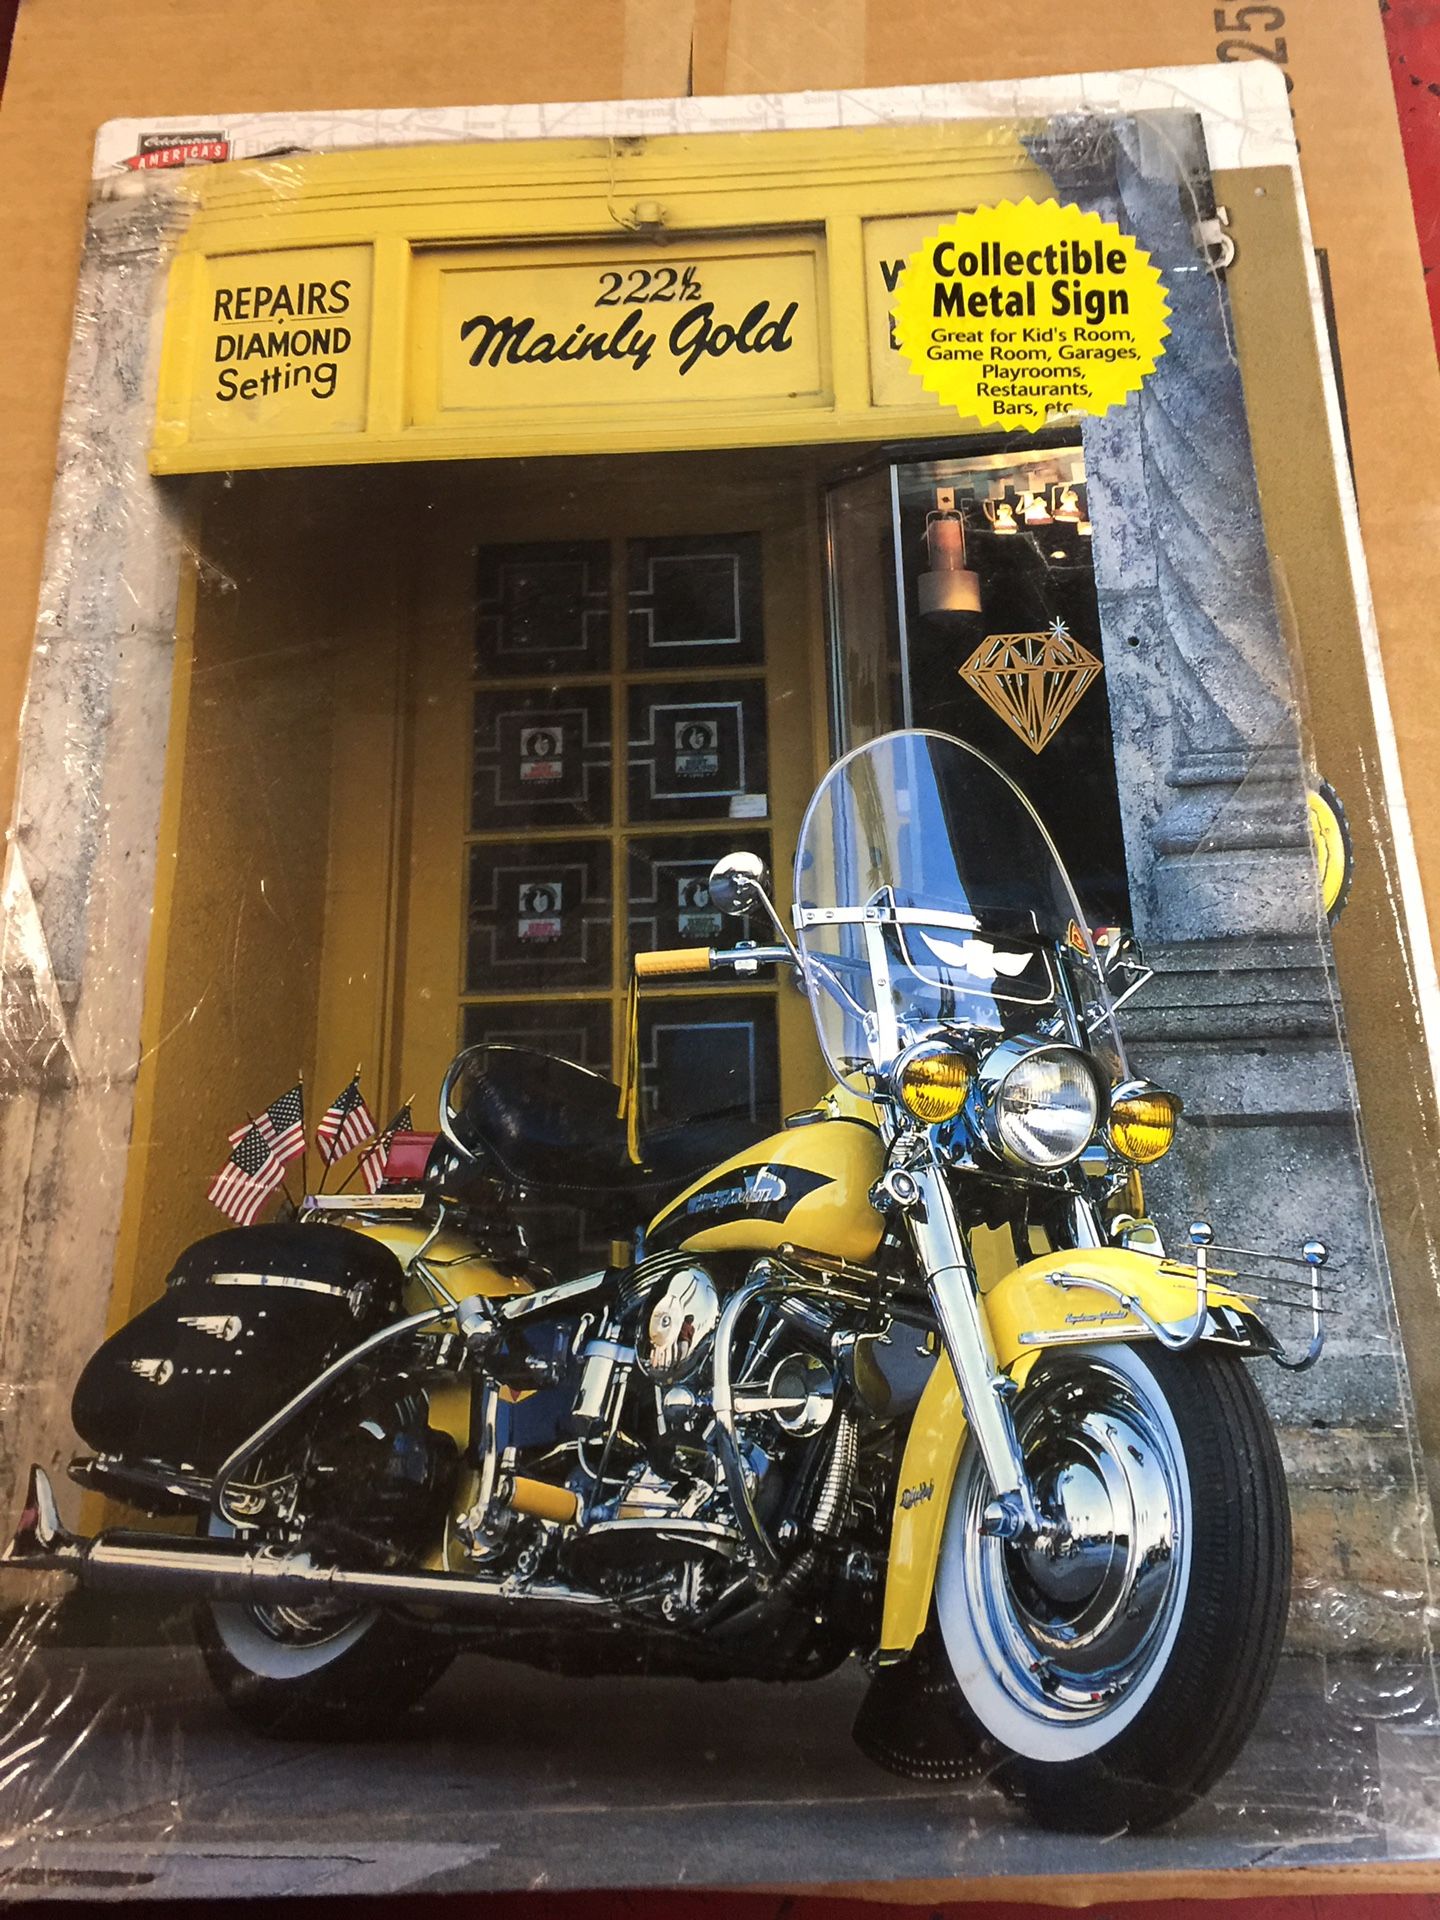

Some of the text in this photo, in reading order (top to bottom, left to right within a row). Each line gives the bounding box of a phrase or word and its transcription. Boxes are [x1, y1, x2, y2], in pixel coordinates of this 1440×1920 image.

[138, 144, 223, 170] AMERICA'S
[932, 239, 1127, 278] Collectible
[213, 279, 351, 322] REPAIRS
[932, 280, 1130, 325] Metal Sign
[214, 327, 352, 363] DIAMOND
[460, 300, 800, 377] Mainly Gold
[930, 327, 1136, 344] Great for Kid's Room,
[926, 344, 1142, 363] Game Room, Garages,
[215, 362, 338, 402] Setting
[981, 363, 1087, 382] Playrooms,
[976, 382, 1094, 398] Restaurants,
[992, 400, 1039, 417] Bars,
